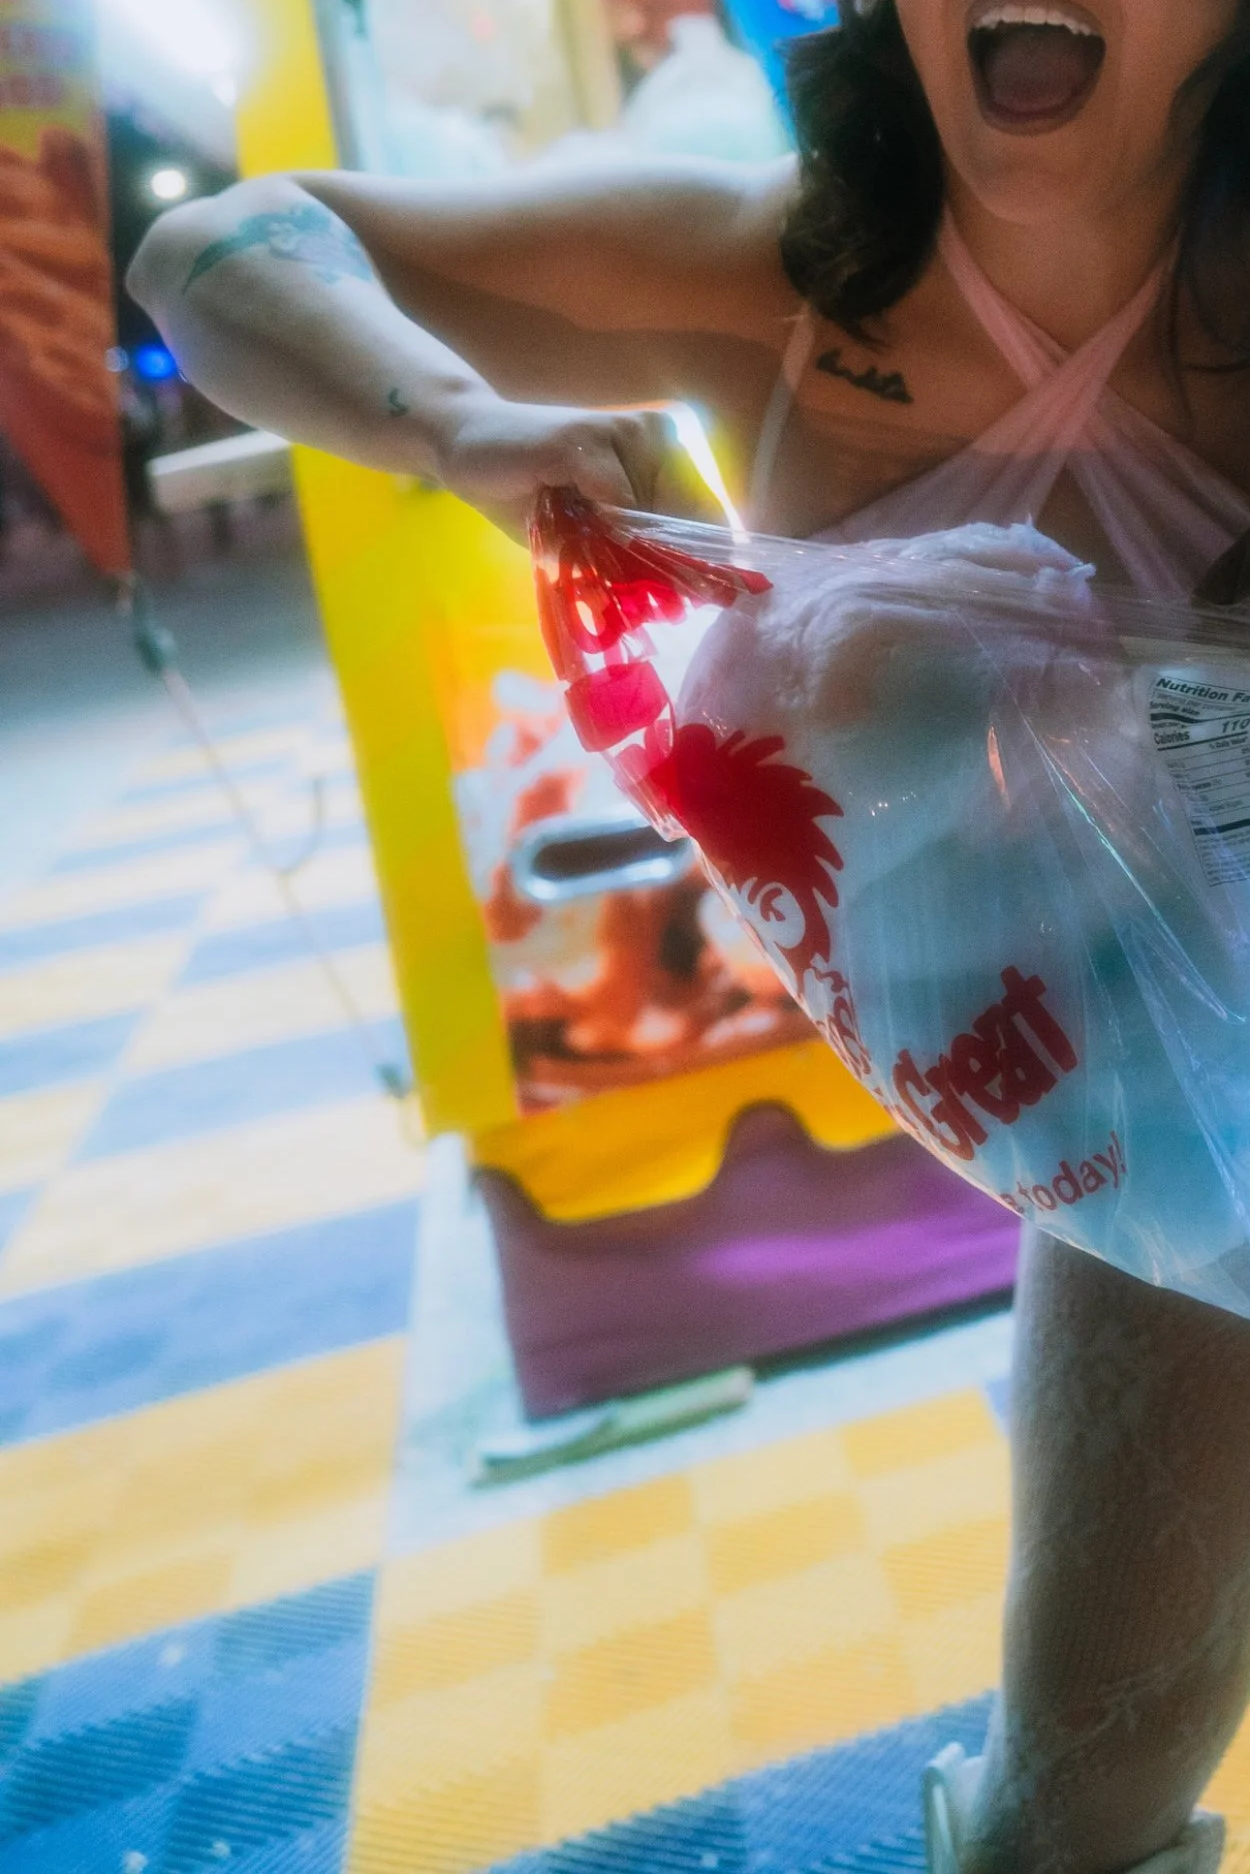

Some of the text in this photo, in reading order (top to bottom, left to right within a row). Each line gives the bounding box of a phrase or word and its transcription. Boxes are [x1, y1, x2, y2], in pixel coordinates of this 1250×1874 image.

[1155, 678, 1229, 702] Nutrition
[1154, 731, 1190, 745] Calories
[893, 966, 1078, 1160] Great
[1017, 1130, 1127, 1210] today!
